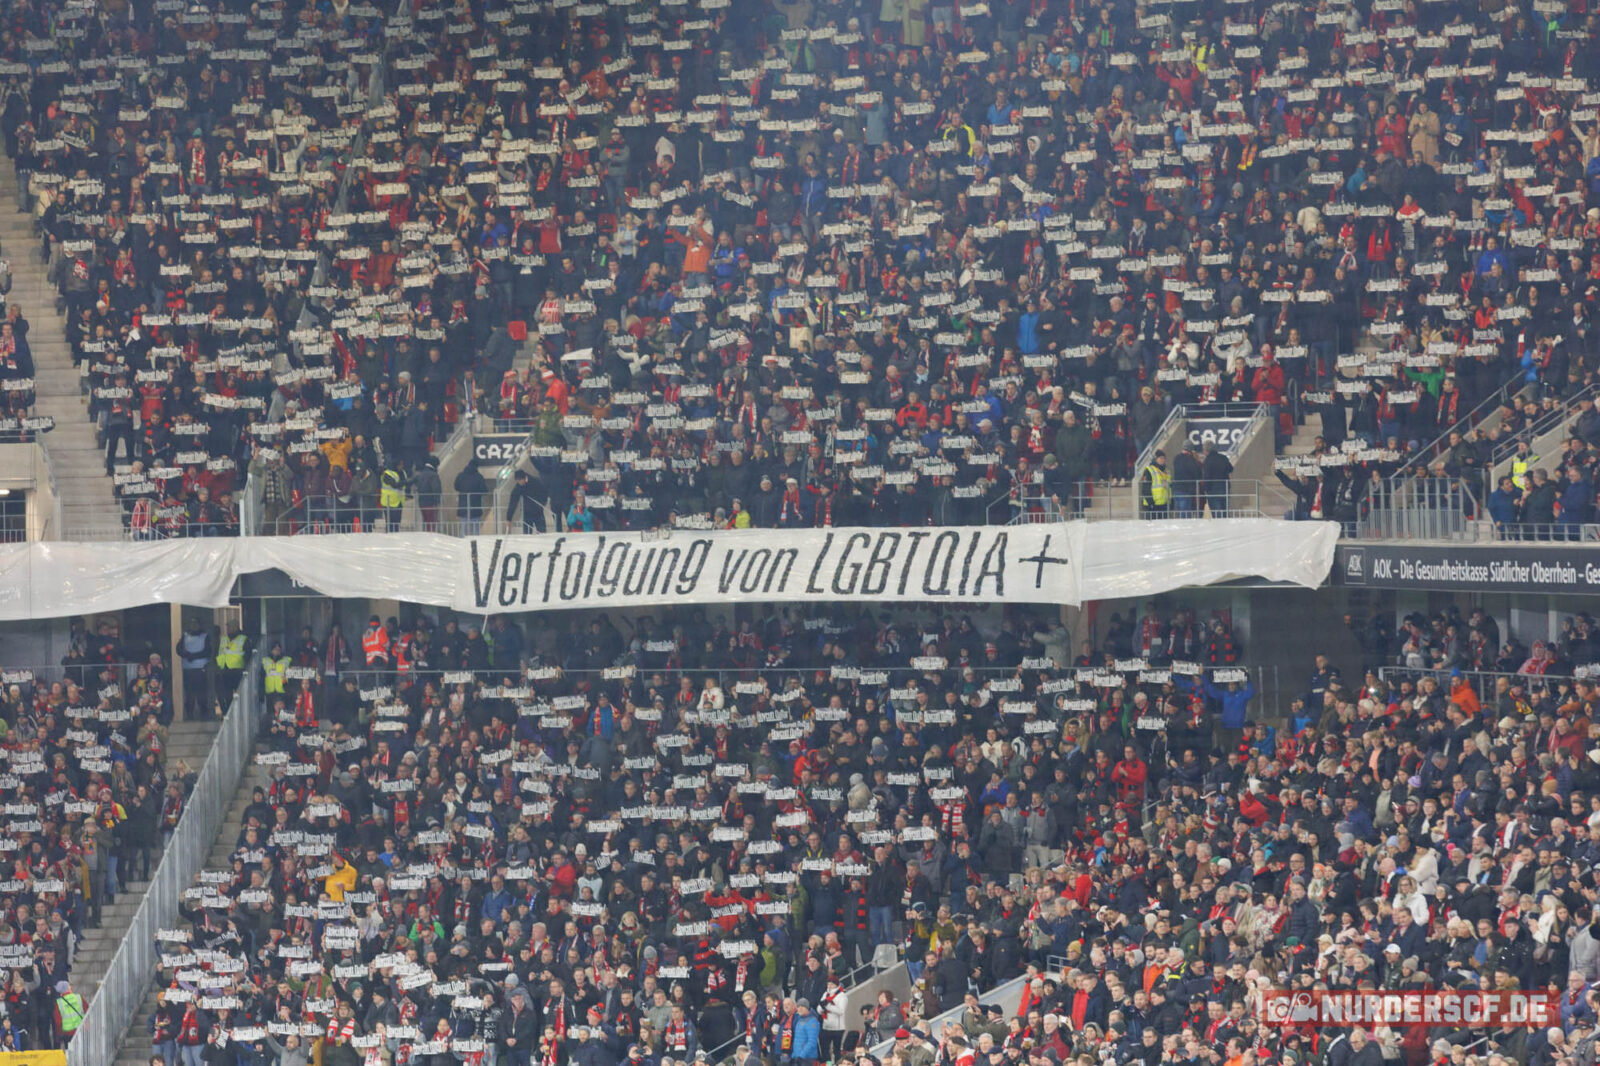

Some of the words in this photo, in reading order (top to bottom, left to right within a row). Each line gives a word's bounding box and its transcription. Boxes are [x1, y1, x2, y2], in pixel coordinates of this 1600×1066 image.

[470, 538, 711, 608] Verfolgung
[718, 547, 798, 594] von
[1373, 558, 1392, 579] AOK
[1400, 558, 1413, 580] Die
[1415, 559, 1488, 582] Gesundheitskasse
[1490, 560, 1530, 582] Südlicher
[1531, 561, 1577, 584] Oberrhein
